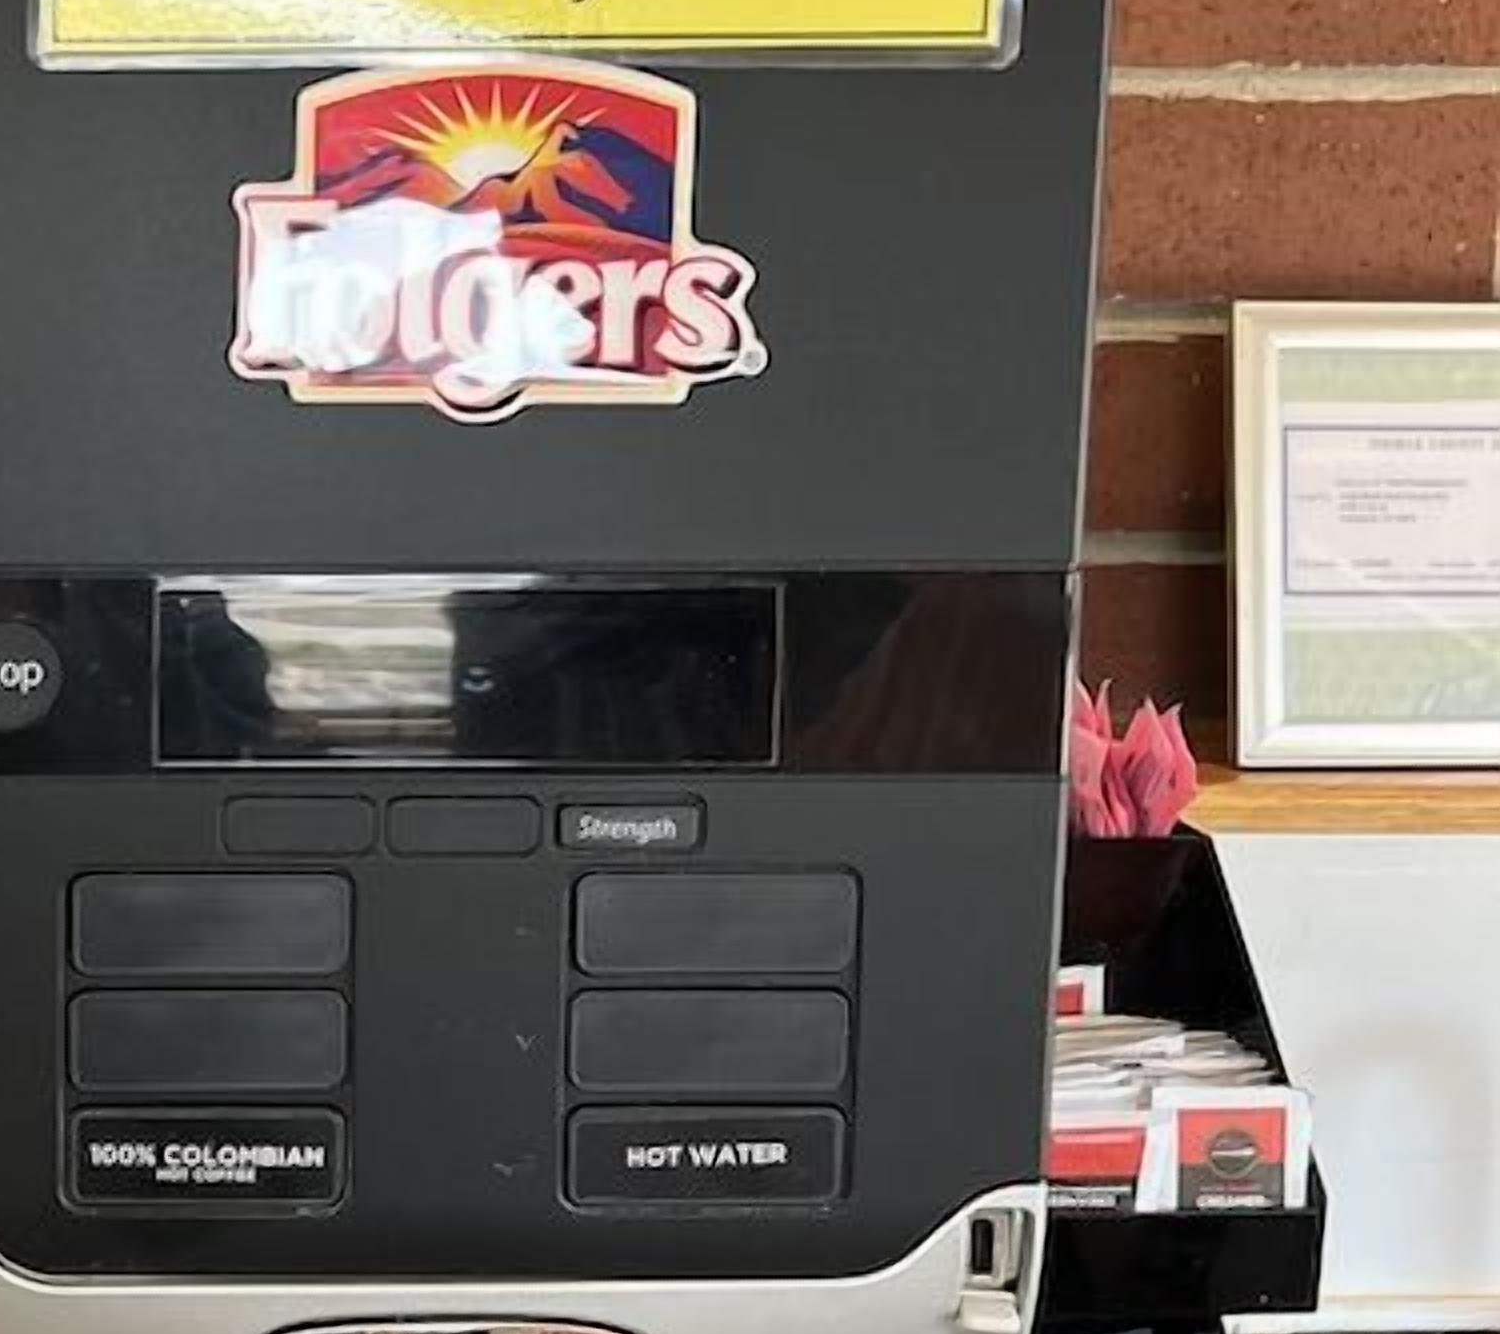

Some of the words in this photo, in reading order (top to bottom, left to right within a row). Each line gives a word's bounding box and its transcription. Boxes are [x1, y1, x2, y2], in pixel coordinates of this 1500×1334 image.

[578, 815, 677, 845] Strength
[89, 1143, 157, 1166] 100%
[163, 1144, 325, 1168] COLOMBIAN
[626, 1145, 683, 1168] HOT
[688, 1142, 788, 1166] WATER
